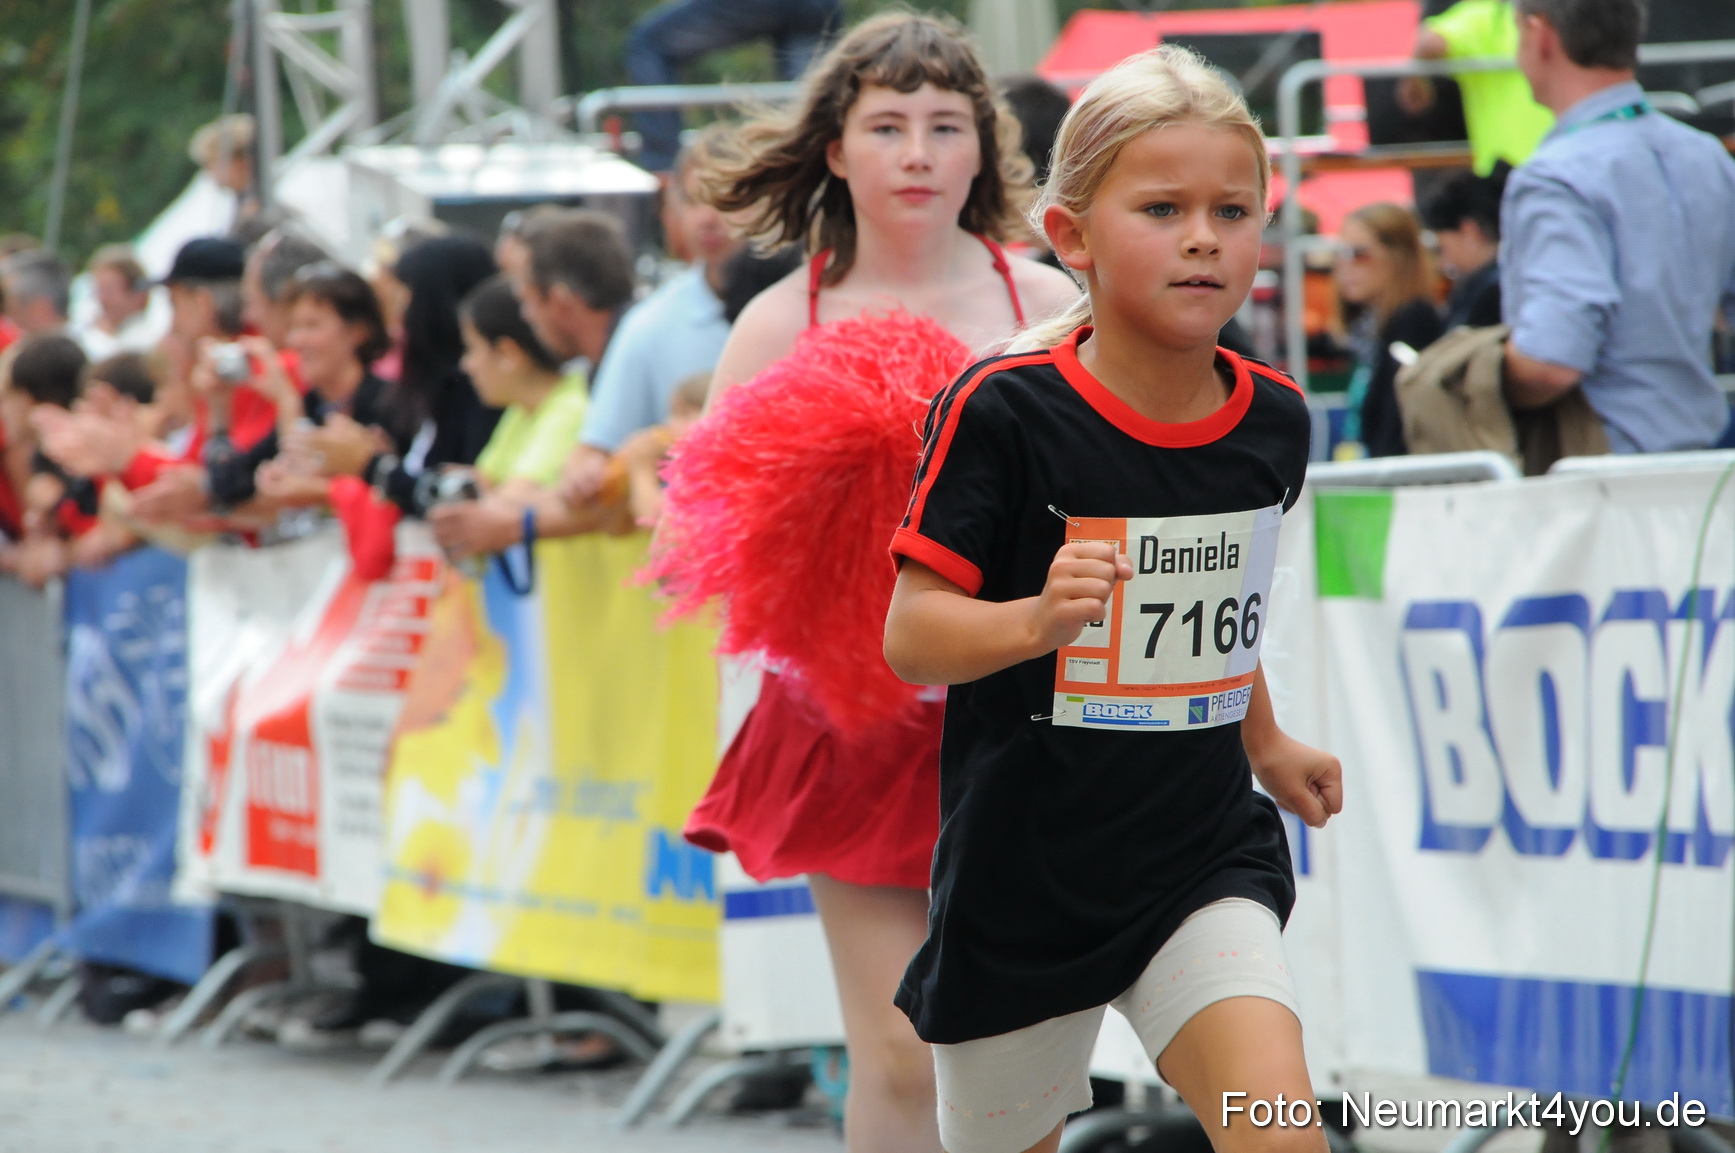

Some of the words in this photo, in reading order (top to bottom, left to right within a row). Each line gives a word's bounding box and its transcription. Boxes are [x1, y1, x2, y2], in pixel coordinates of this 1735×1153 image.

[1139, 531, 1239, 574] Daniela
[1140, 592, 1262, 658] 7166
[1083, 702, 1153, 719] BOCK
[1402, 586, 1735, 869] BOCK
